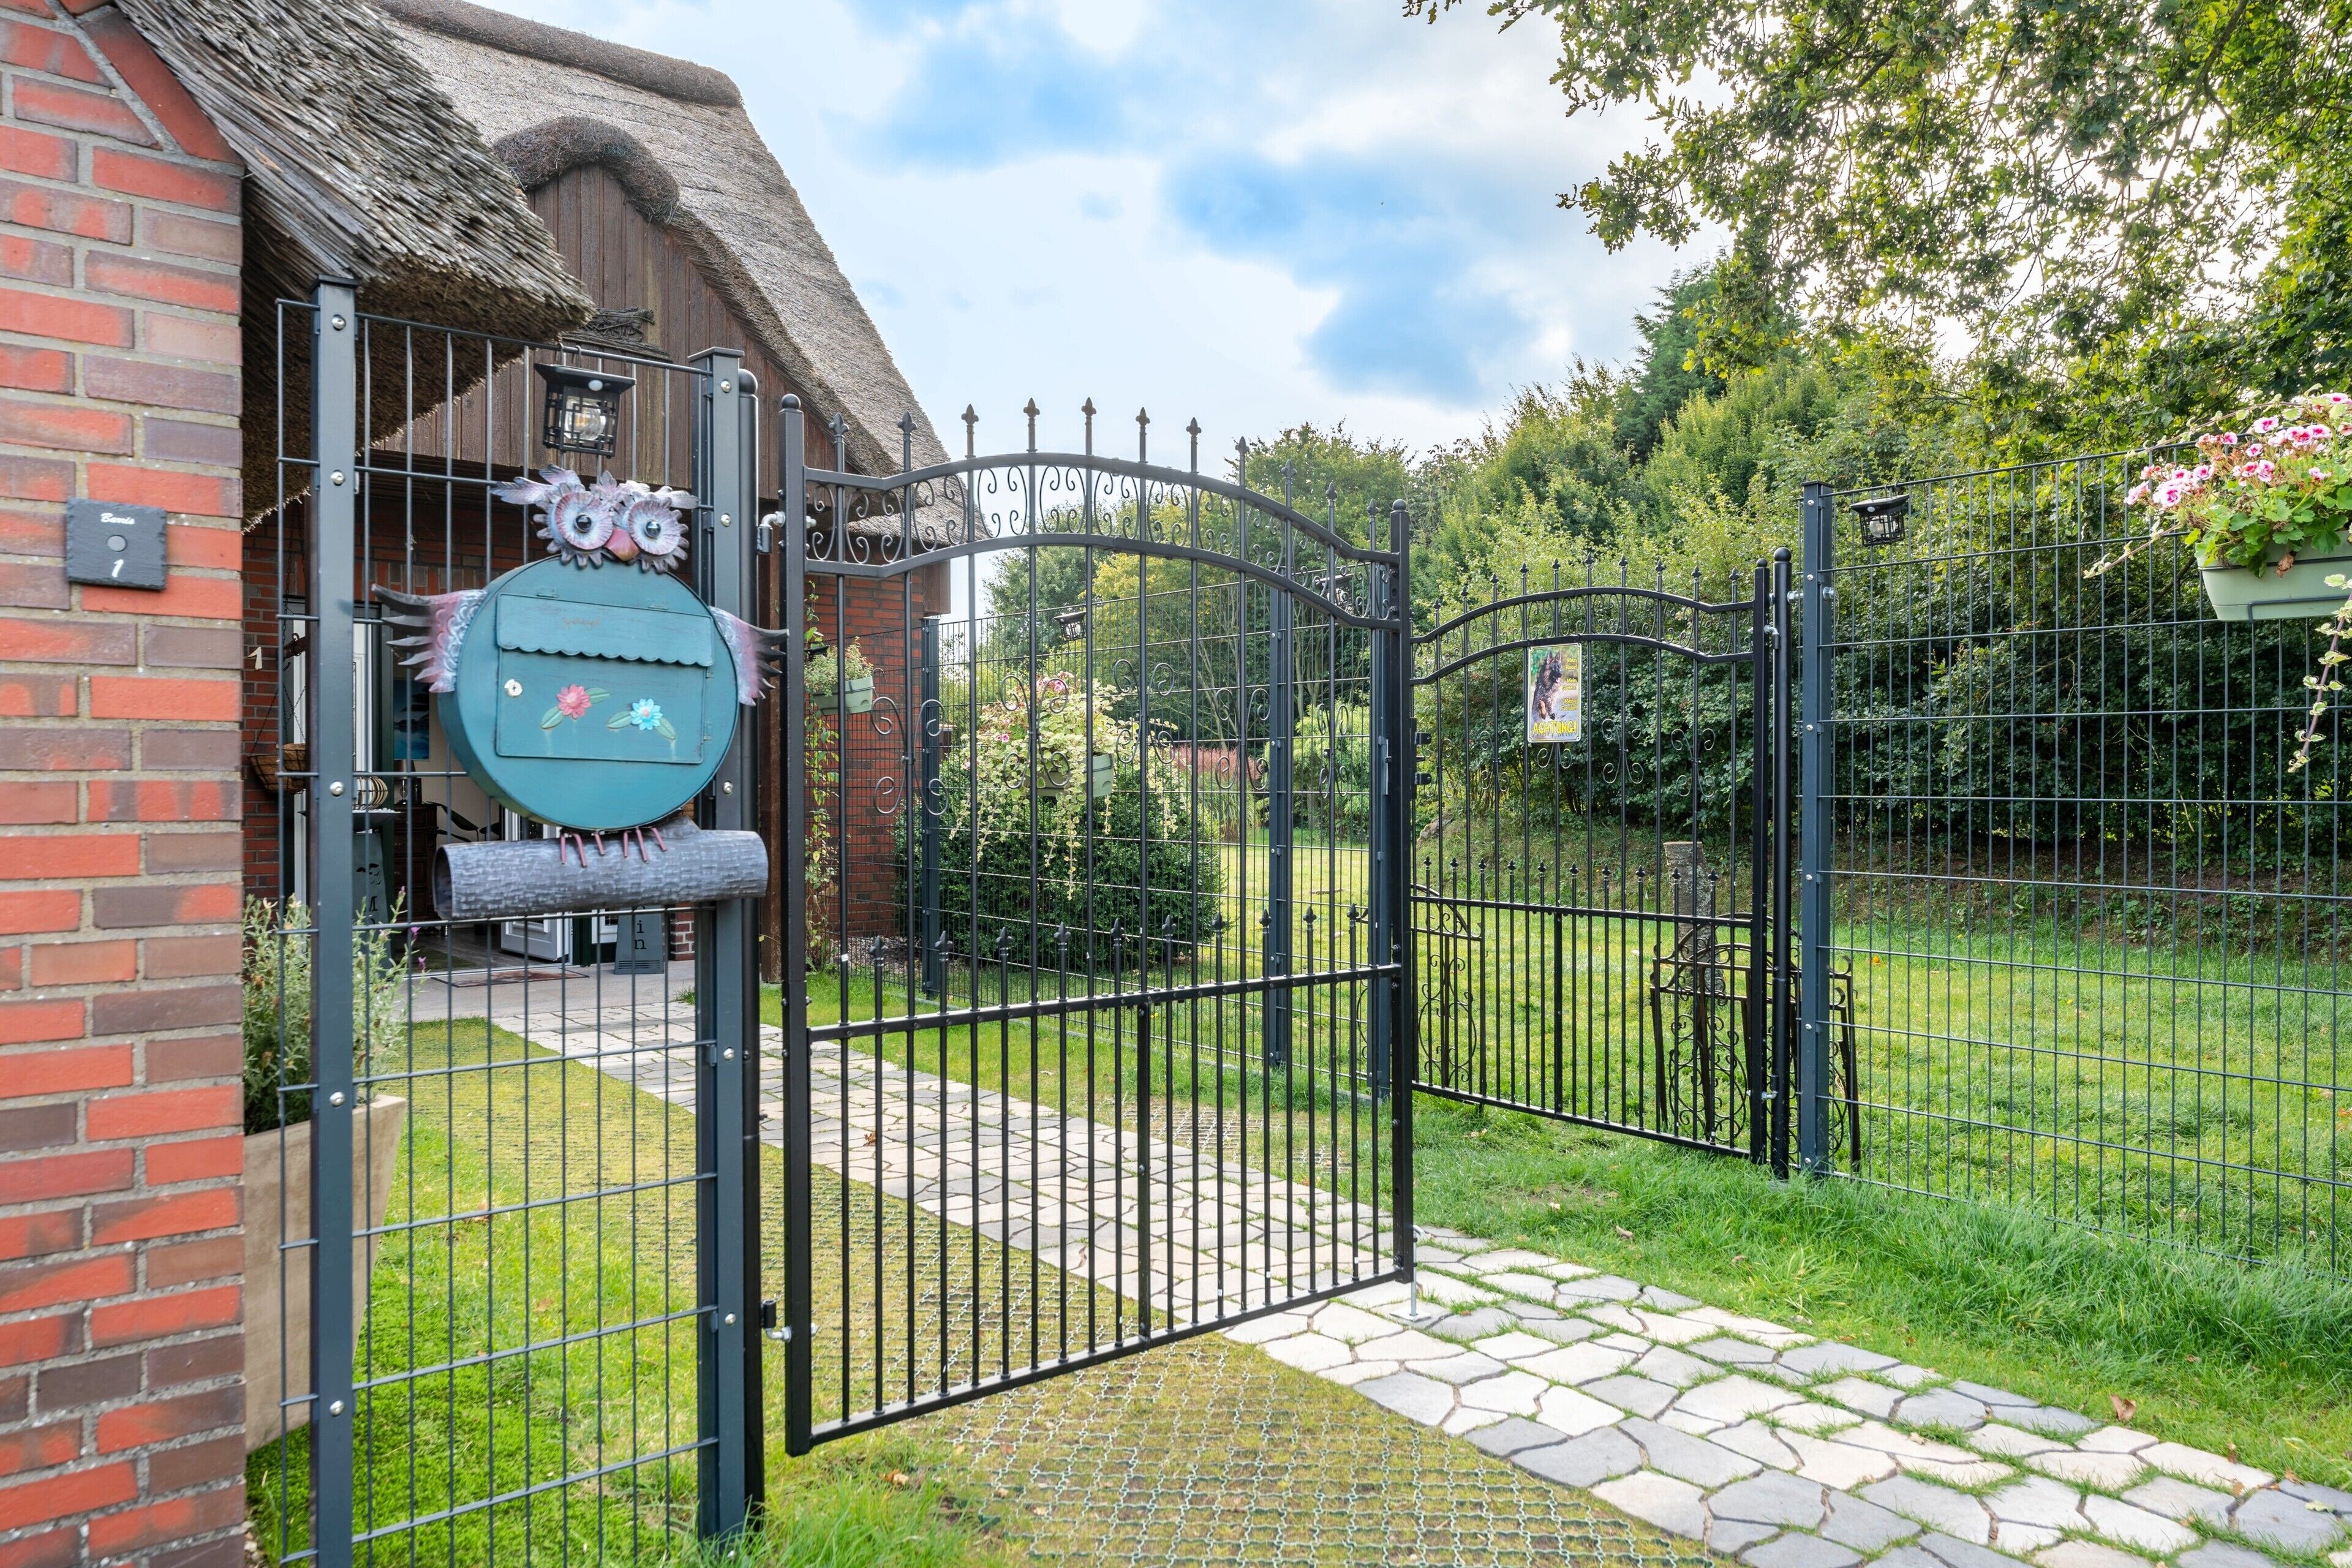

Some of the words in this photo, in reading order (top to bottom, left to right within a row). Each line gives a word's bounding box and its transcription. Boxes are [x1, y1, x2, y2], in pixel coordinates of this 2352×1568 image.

[111, 559, 124, 578] 1
[247, 646, 263, 670] 1
[1532, 720, 1577, 735] ACHTUNG!
